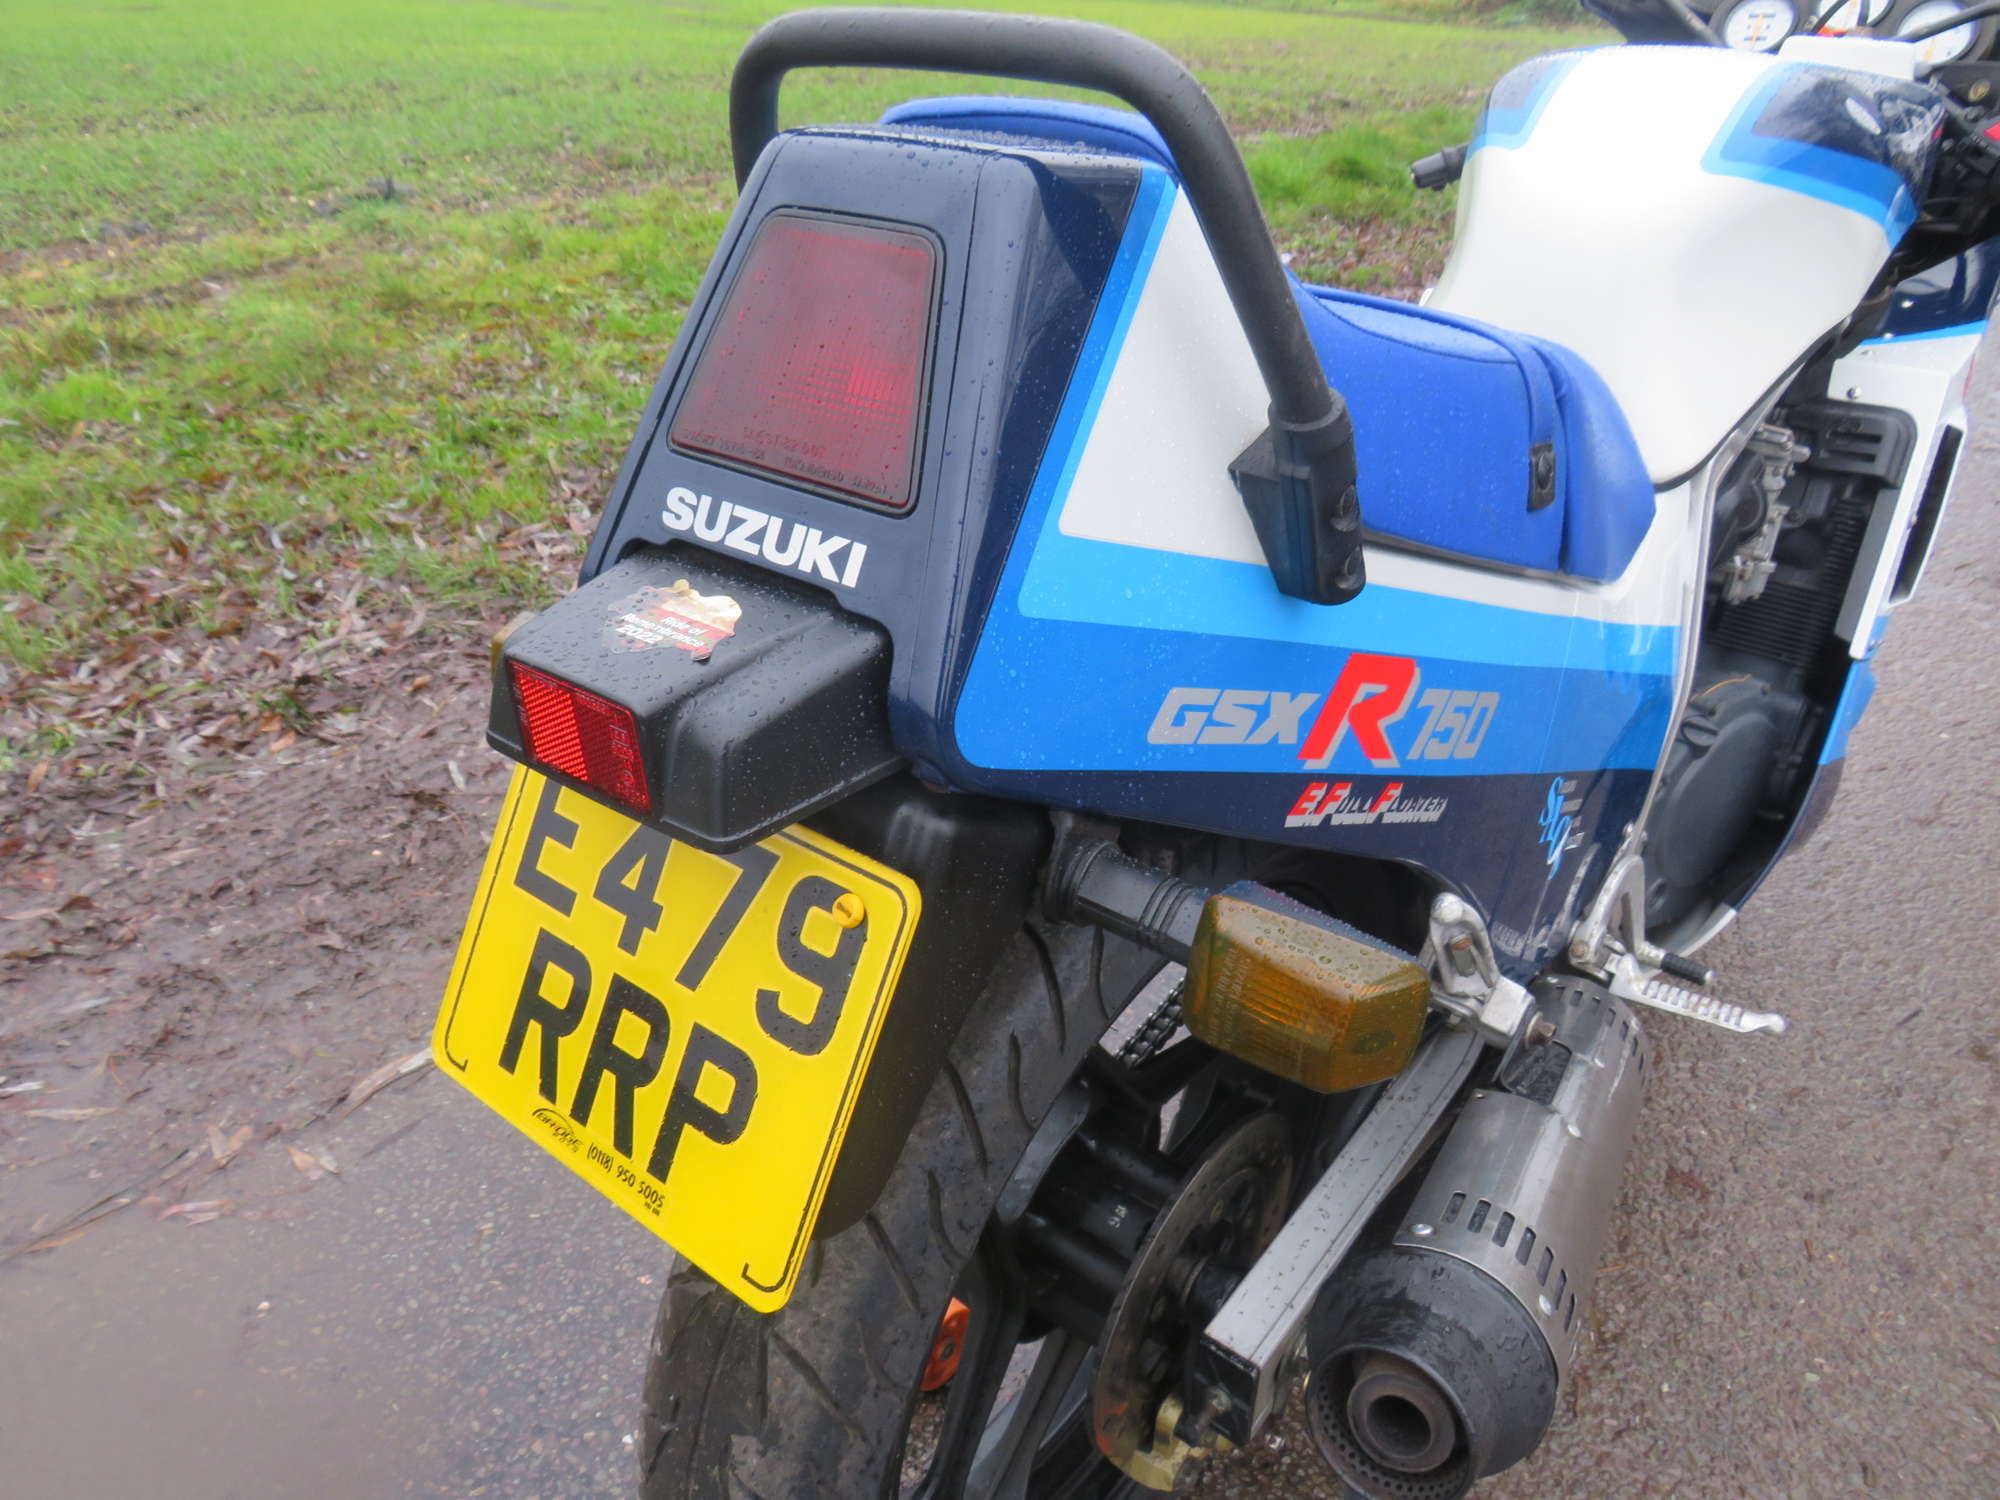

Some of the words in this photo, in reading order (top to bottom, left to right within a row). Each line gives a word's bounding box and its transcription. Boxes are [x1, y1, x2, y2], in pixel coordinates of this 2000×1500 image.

[662, 487, 868, 588] SUZUKI
[615, 624, 663, 644] 2022
[1406, 688, 1499, 760] 750
[514, 779, 868, 1056] E479
[499, 927, 758, 1184] RRP
[587, 1142, 614, 1174] (0118)
[616, 1164, 636, 1187] 950
[637, 1180, 666, 1208] 5005
